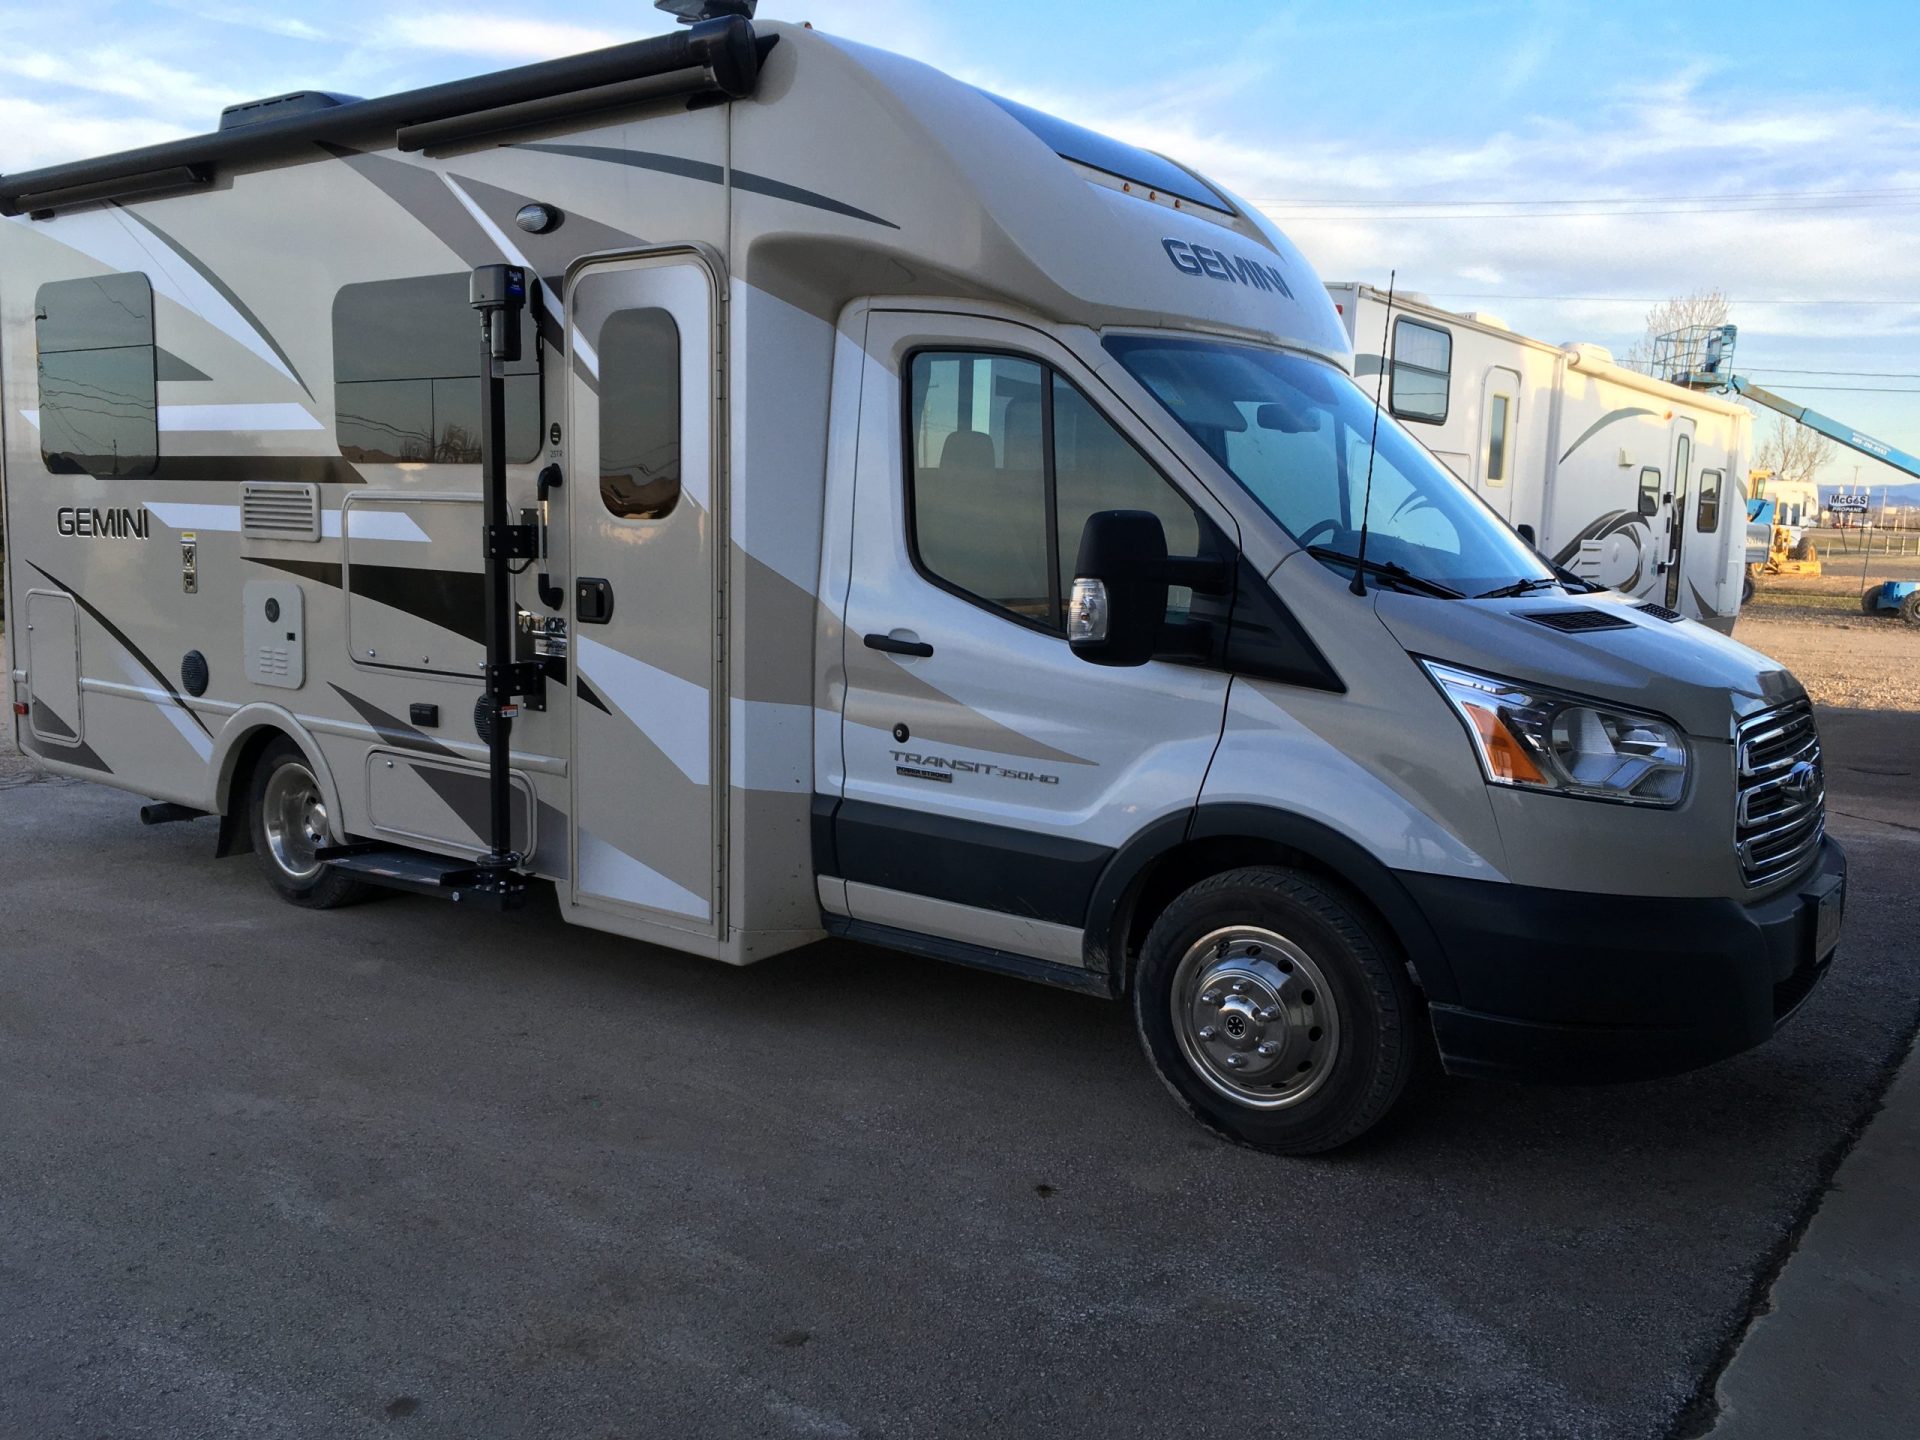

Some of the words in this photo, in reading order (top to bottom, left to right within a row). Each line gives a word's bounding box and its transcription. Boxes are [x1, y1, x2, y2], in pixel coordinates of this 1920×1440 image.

[1160, 237, 1295, 301] GEMINI
[57, 506, 149, 540] GEMINI
[1831, 505, 1863, 513] PROPANE
[889, 749, 998, 775] TRANSIT
[995, 767, 1060, 785] 350HD
